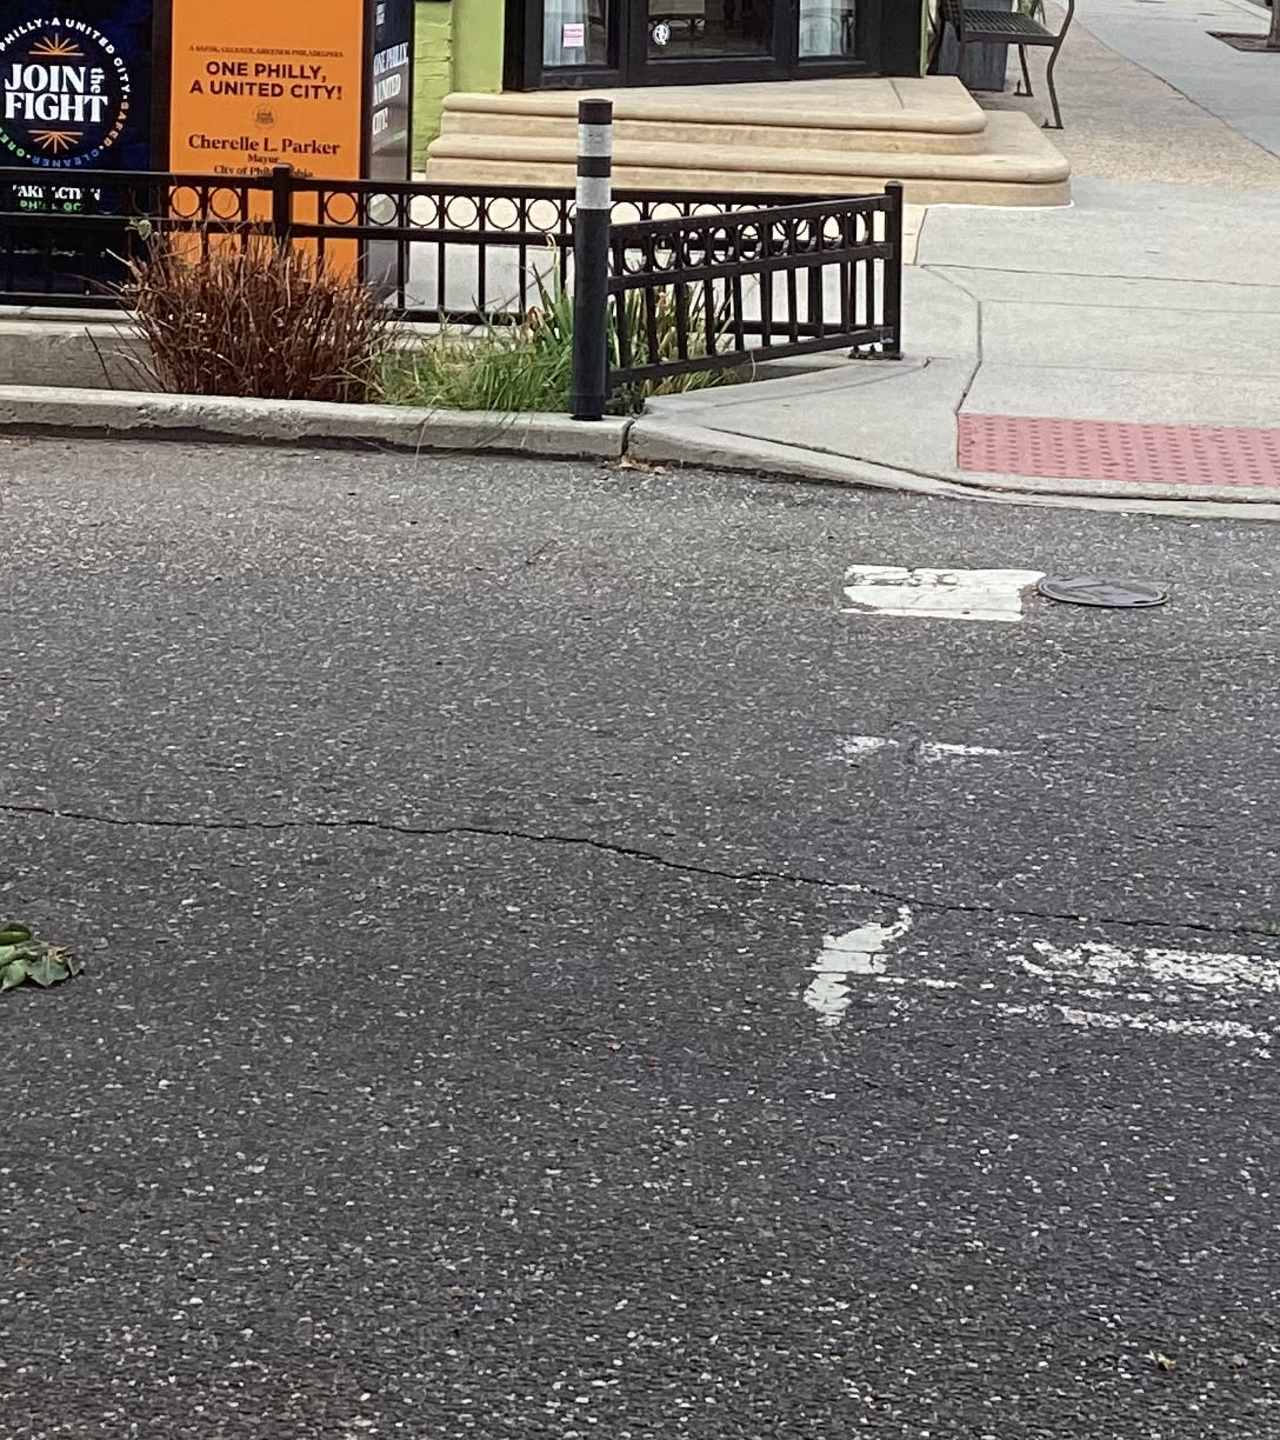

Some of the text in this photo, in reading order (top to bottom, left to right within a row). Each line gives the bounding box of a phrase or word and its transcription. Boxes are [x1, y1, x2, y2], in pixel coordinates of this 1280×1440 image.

[51, 17, 61, 26] A
[65, 18, 115, 54] UNITED
[113, 57, 131, 93] CITY
[4, 63, 105, 94] JOIN the
[206, 61, 327, 83] ONE PHILLY,
[189, 80, 343, 100] A UNITED CITY!
[5, 92, 108, 122] FIGHT
[188, 134, 259, 152] Cherelle
[281, 138, 340, 156] Parker
